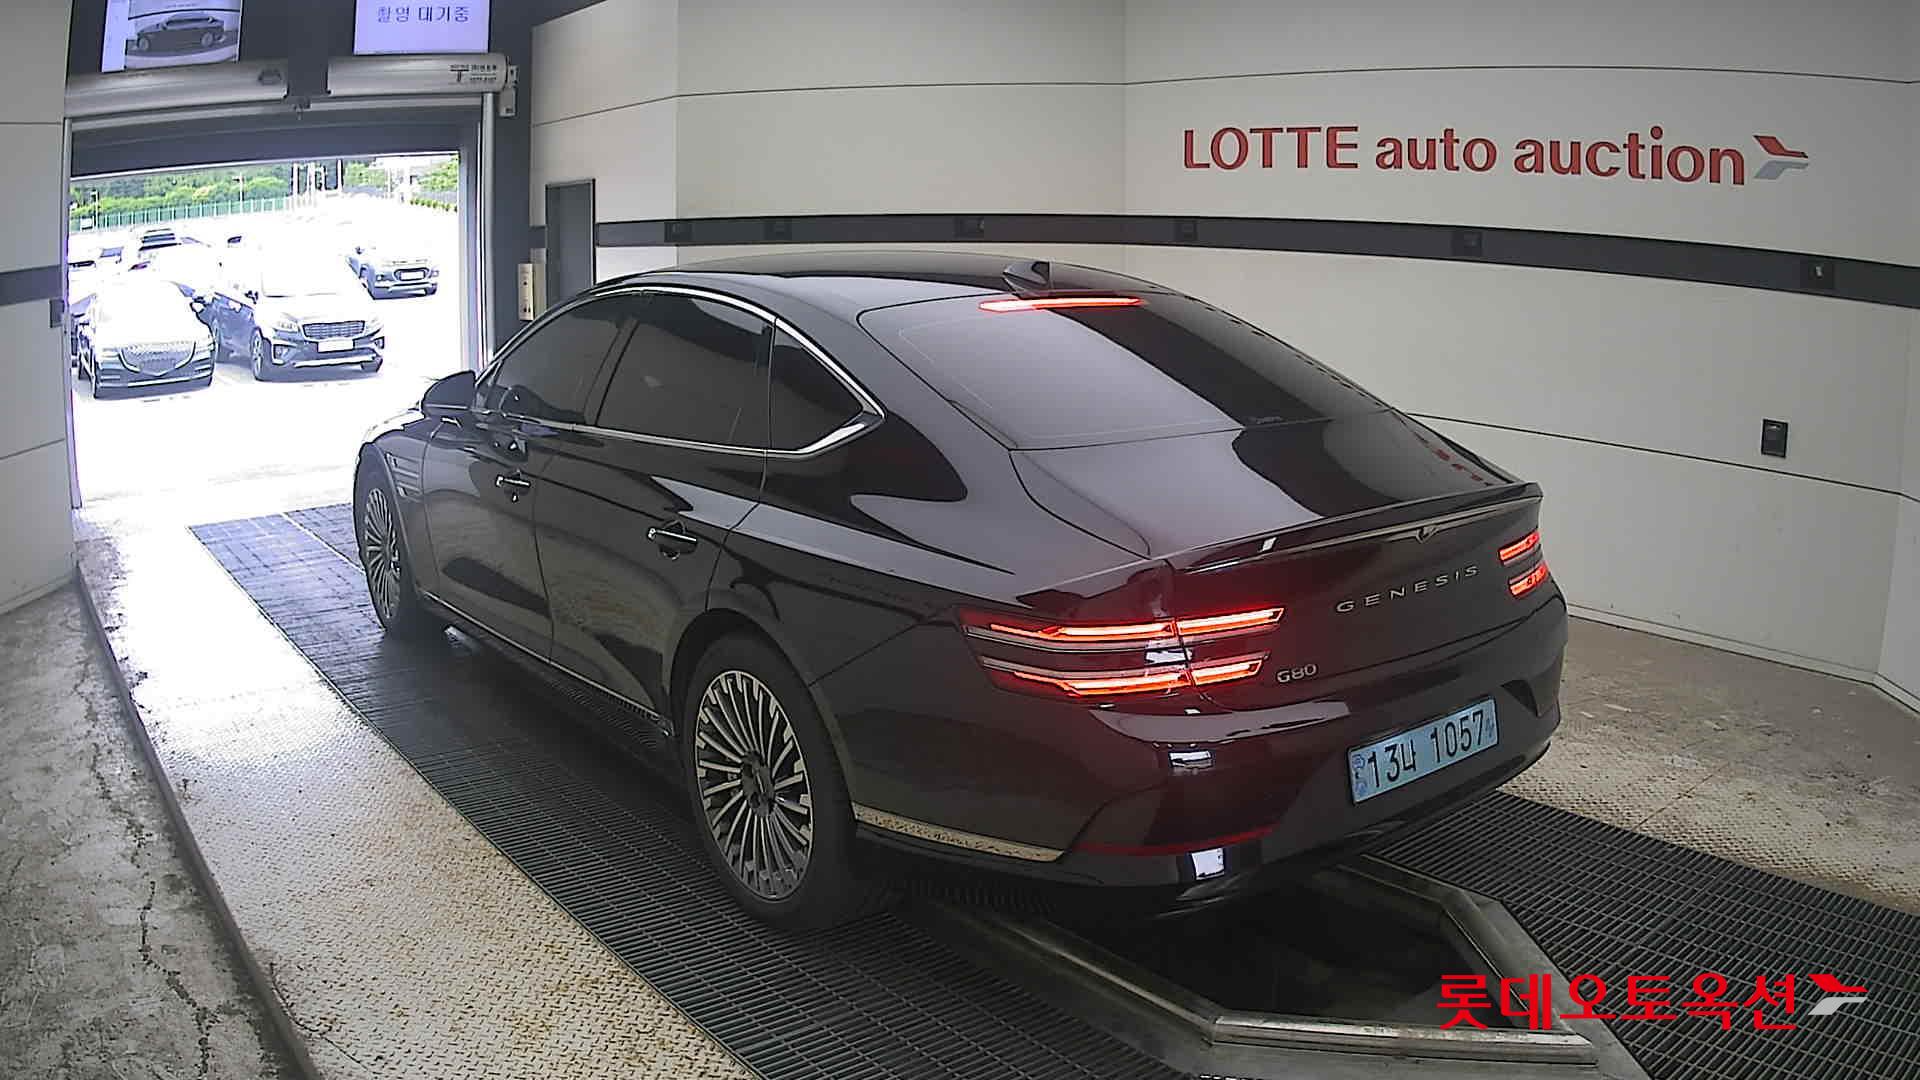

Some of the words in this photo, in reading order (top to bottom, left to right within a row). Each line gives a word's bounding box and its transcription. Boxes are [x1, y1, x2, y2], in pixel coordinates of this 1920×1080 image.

[418, 6, 469, 23] 대기중
[1184, 126, 1359, 169] LOTTE
[1375, 129, 1497, 171] auto
[1514, 126, 1744, 186] auction
[1336, 565, 1479, 613] GENESIS
[1277, 663, 1317, 684] G80
[1430, 710, 1484, 762] 1057
